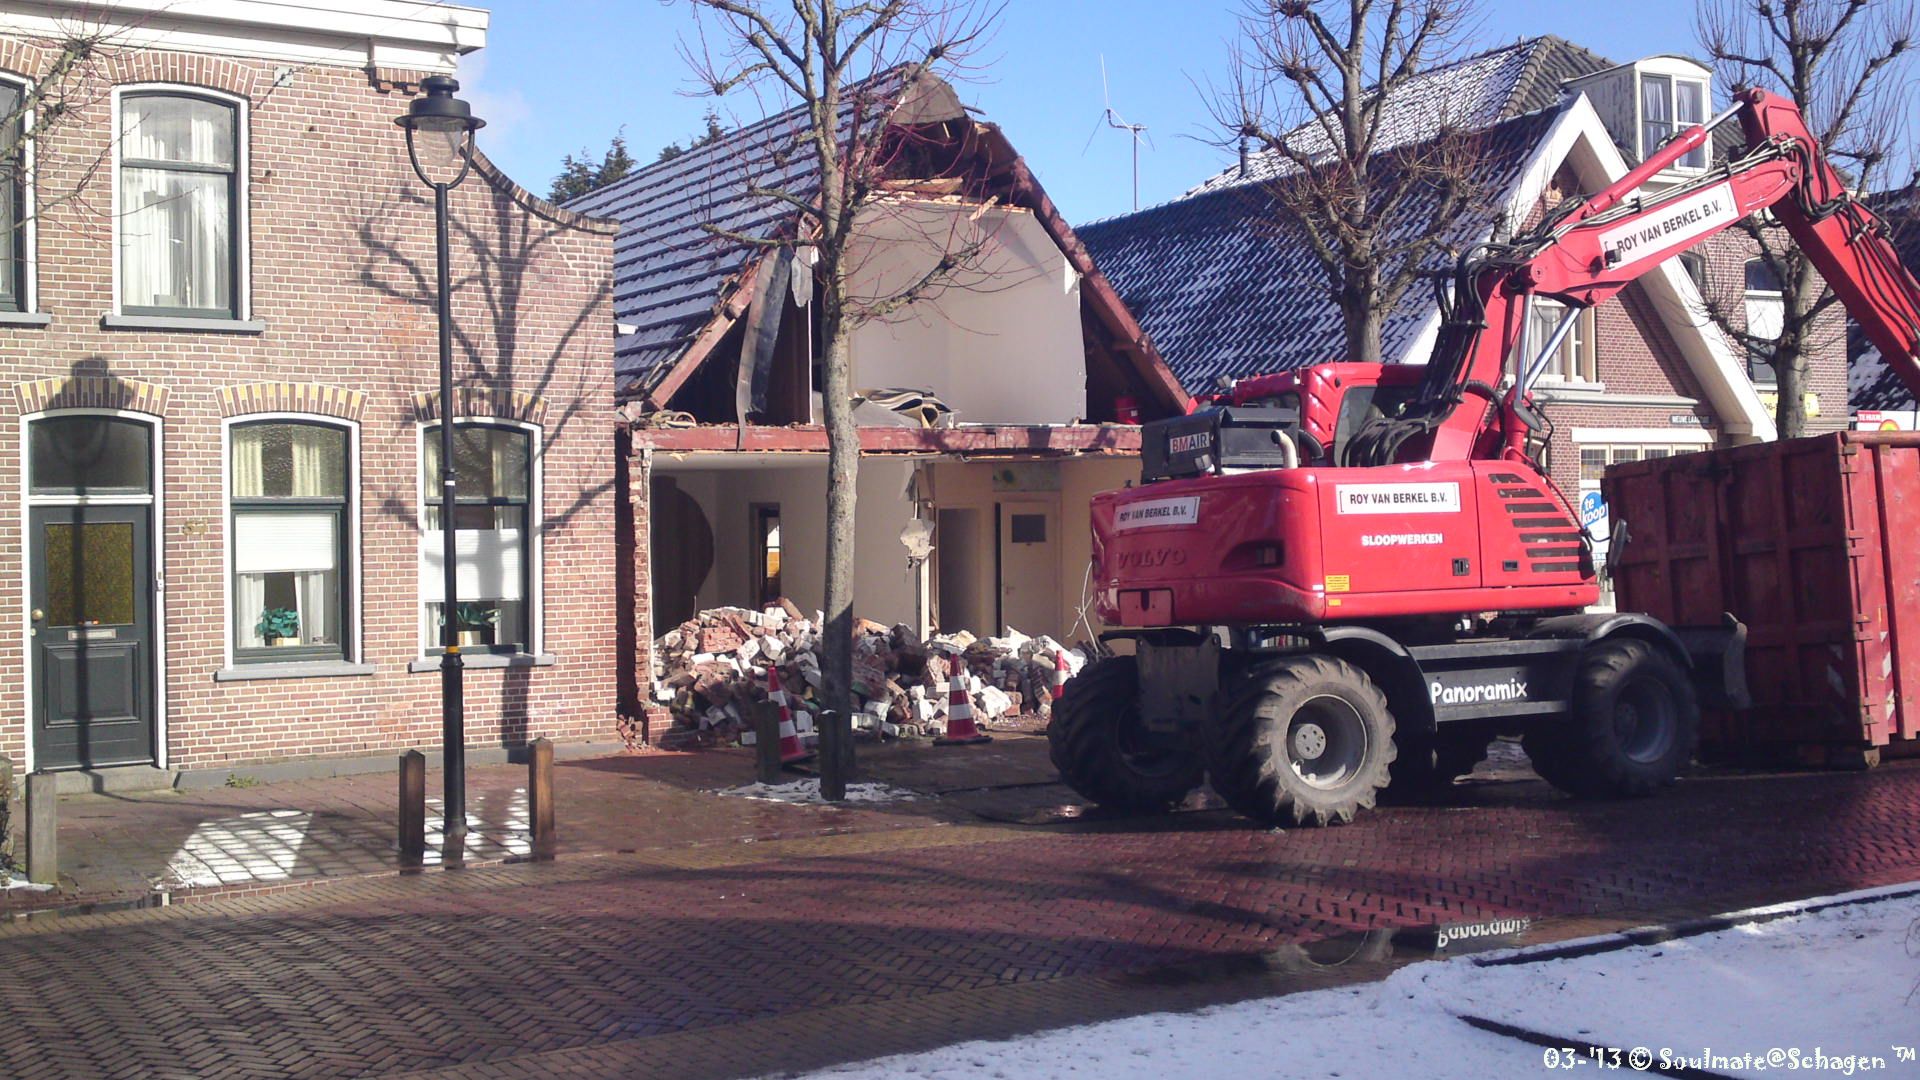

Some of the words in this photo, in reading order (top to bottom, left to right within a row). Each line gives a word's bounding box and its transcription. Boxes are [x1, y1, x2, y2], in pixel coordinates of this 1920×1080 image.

[1616, 234, 1639, 253] ROY
[1639, 225, 1662, 243] VAN
[1662, 208, 1702, 234] BERKEL
[1702, 199, 1722, 217] B.V.
[1171, 433, 1208, 452] BMAIR
[1349, 493, 1369, 504] ROY
[1371, 493, 1391, 504] VAN
[1393, 492, 1429, 504] BERKEL
[1430, 492, 1448, 503] B.V.
[1584, 497, 1595, 511] te
[1119, 511, 1131, 521] ROY
[1131, 508, 1145, 520] VAN
[1144, 506, 1171, 518] BERKEL
[1172, 505, 1187, 516] B.V.
[1582, 504, 1606, 526] koop
[1361, 533, 1444, 546] SLOOPWERKEN
[1118, 547, 1187, 569] VOLVO
[1431, 678, 1528, 704] Panoramix
